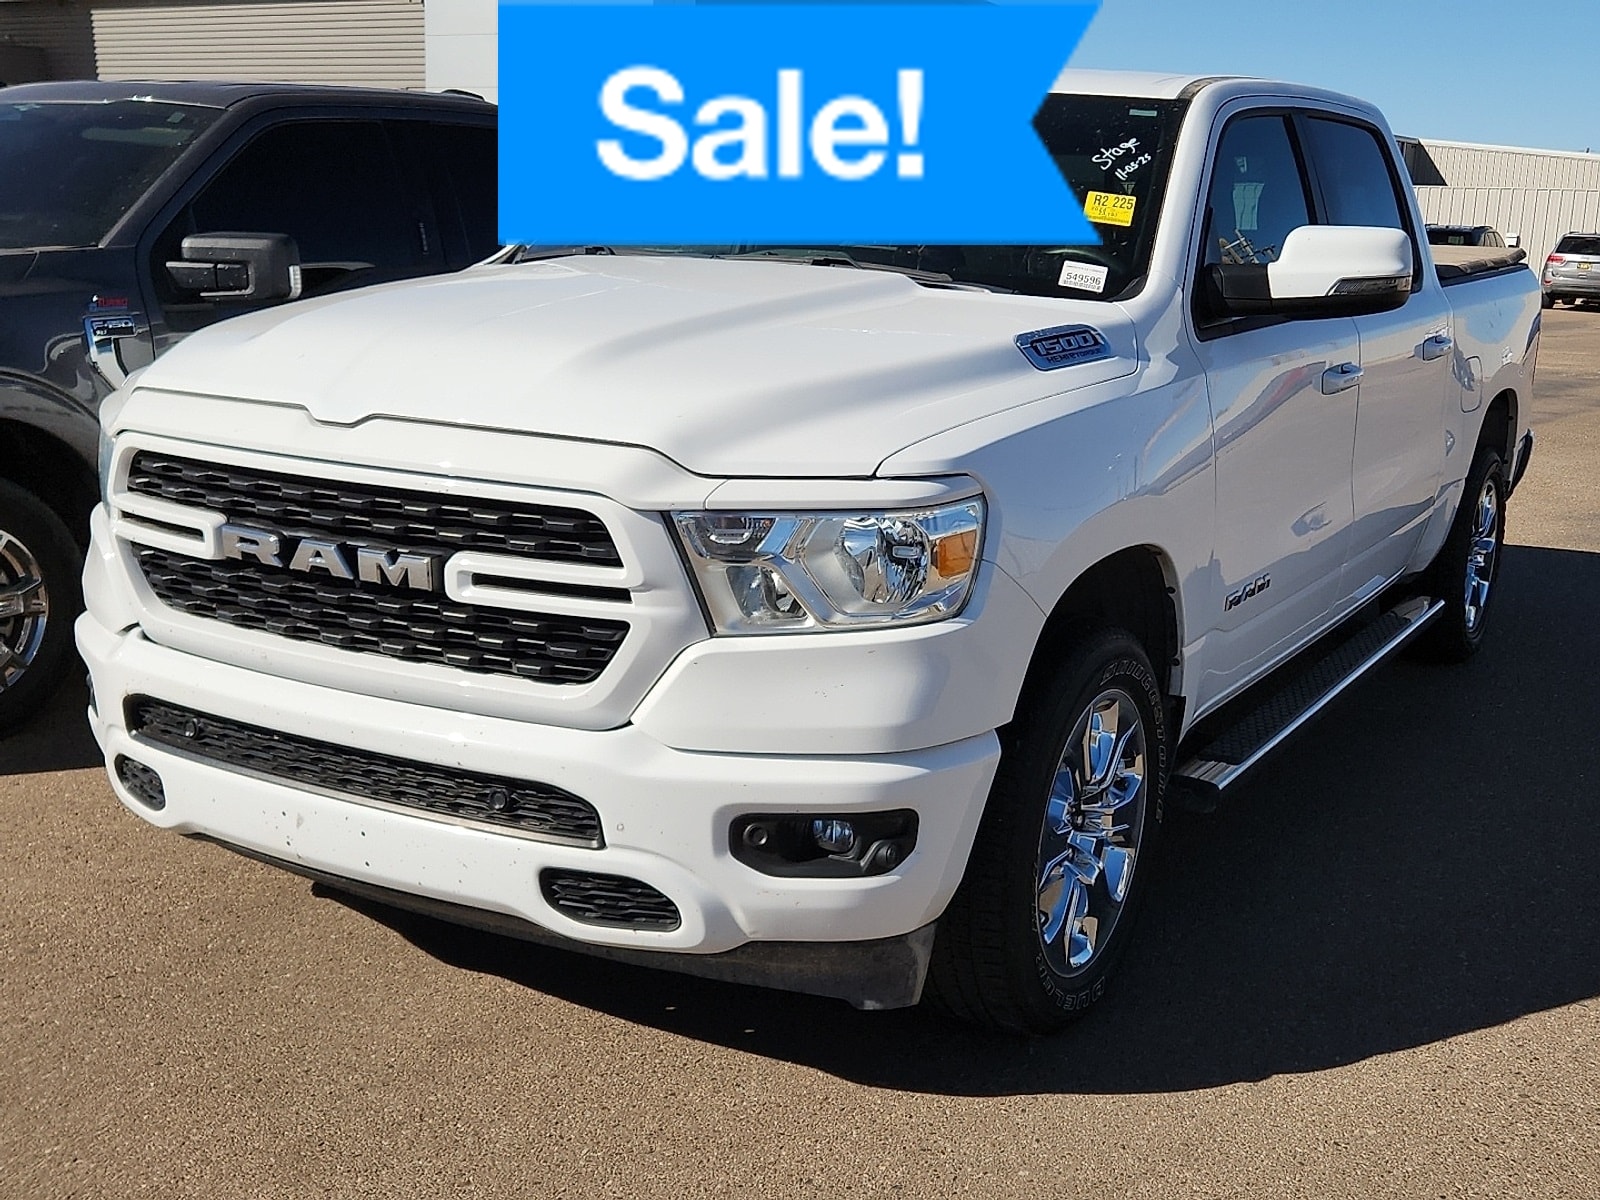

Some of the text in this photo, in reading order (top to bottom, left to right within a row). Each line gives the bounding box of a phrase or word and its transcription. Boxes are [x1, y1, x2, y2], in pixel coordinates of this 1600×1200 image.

[1091, 138, 1141, 170] Stage
[1093, 194, 1134, 210] R2 225
[1066, 272, 1102, 286] 549596
[1034, 333, 1095, 355] 1500
[222, 523, 437, 592] RAM
[1224, 573, 1271, 612] RAM
